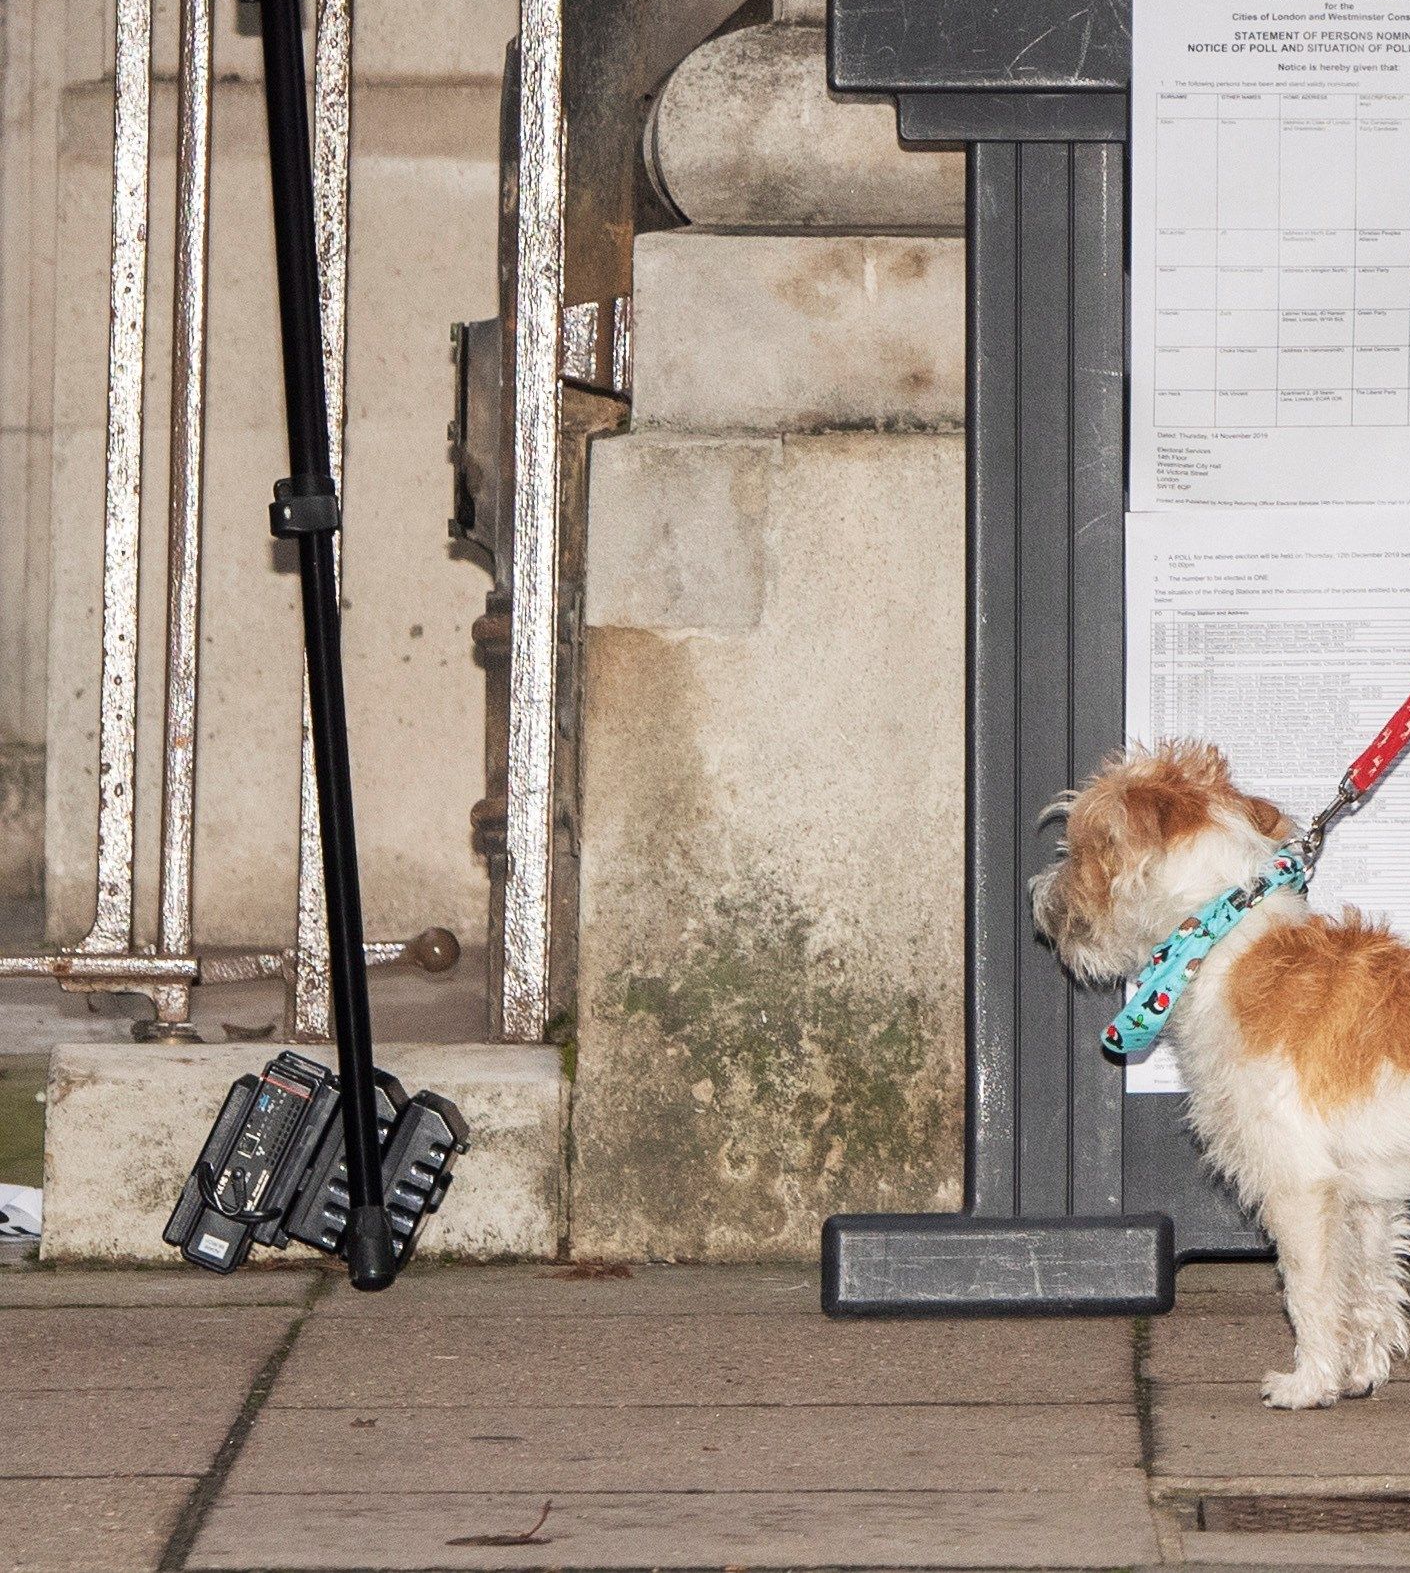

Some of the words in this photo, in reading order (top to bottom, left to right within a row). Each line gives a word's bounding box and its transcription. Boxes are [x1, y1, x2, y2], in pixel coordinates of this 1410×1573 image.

[1231, 12, 1257, 21] Cities
[1259, 12, 1269, 20] of
[1271, 13, 1306, 21] London
[1234, 31, 1299, 40] STATEMENT
[1302, 30, 1316, 40] OF
[1320, 31, 1373, 40] PERSONS
[1187, 43, 1226, 52] NOTICE
[1230, 43, 1244, 52] OF
[1248, 43, 1276, 52] POLL
[1280, 43, 1303, 52] AND
[1306, 43, 1364, 52] SITUATION
[1367, 43, 1381, 52] OF
[1277, 63, 1306, 71] Notice
[1319, 63, 1350, 72] hereby
[1352, 65, 1377, 73] given
